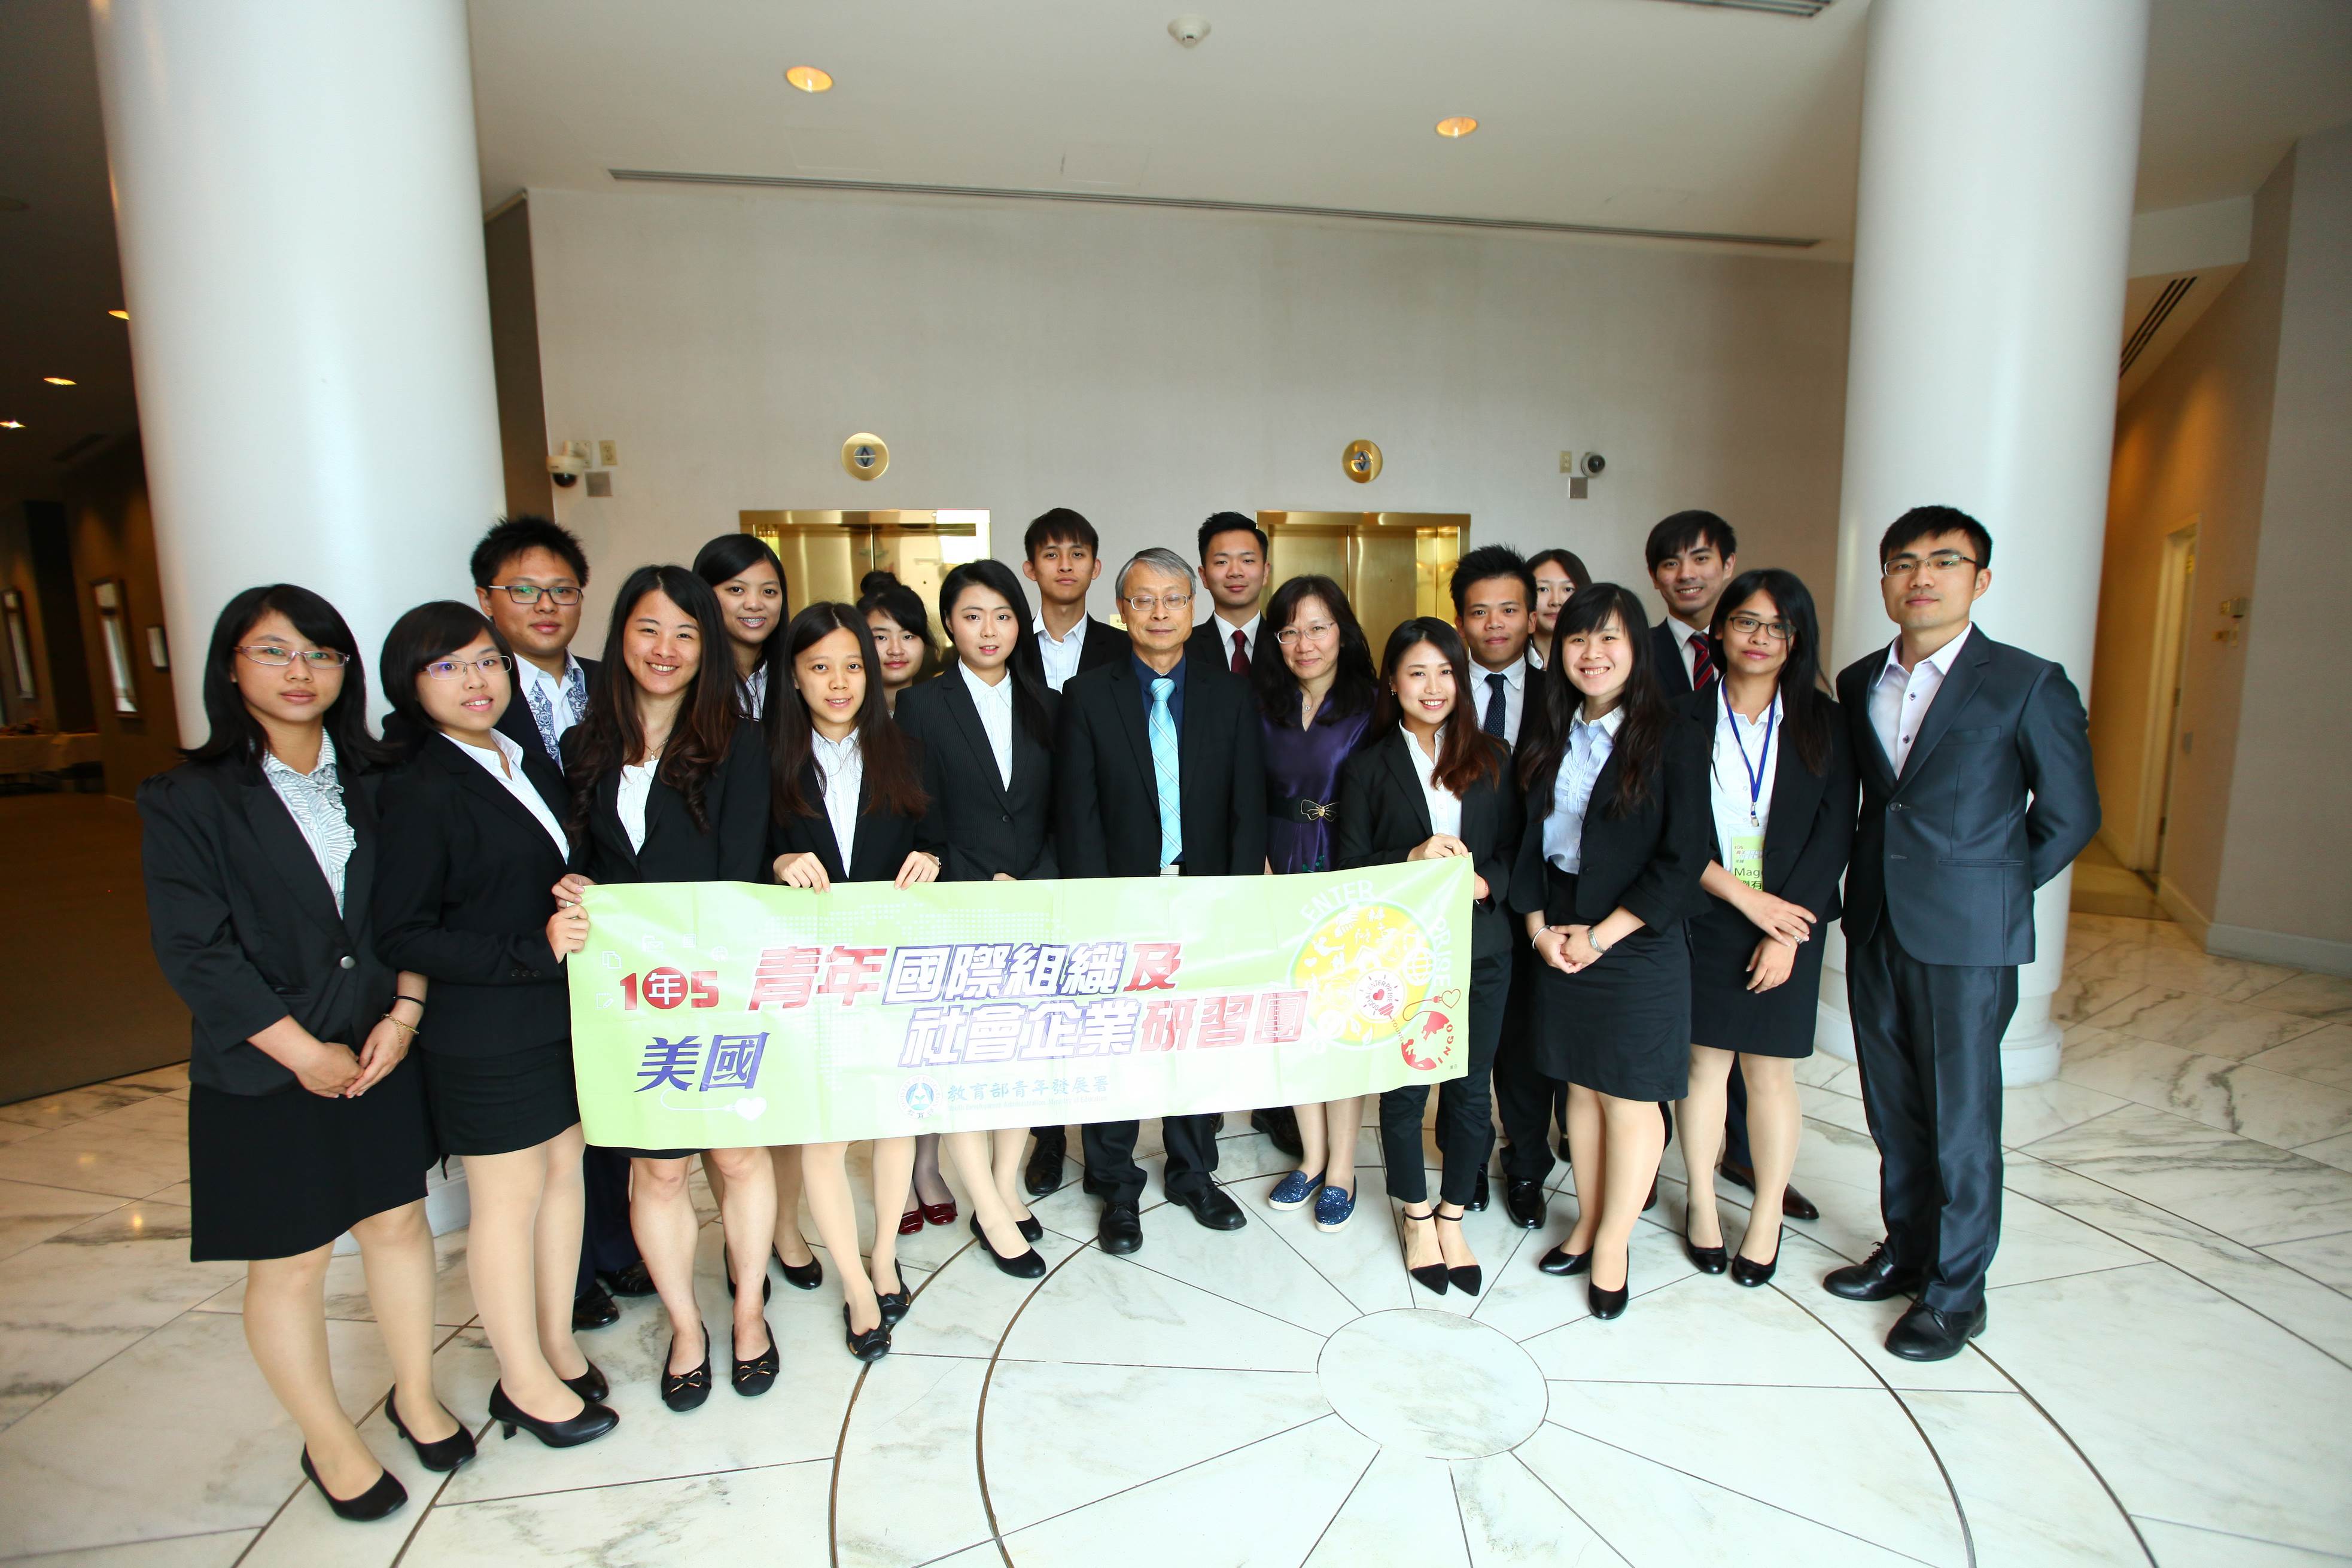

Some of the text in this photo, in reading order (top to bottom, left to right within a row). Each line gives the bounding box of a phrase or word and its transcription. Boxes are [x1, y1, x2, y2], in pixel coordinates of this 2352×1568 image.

[1735, 868, 1762, 878] Mag
[748, 942, 1182, 1010] 青年國際組織及
[898, 991, 1309, 1068] 社會企業研習團
[1391, 1018, 1405, 1042] YOUNG
[1437, 1024, 1454, 1064] INGO
[634, 1032, 770, 1092] 美國
[948, 1076, 1109, 1102] 教育部青年發展署
